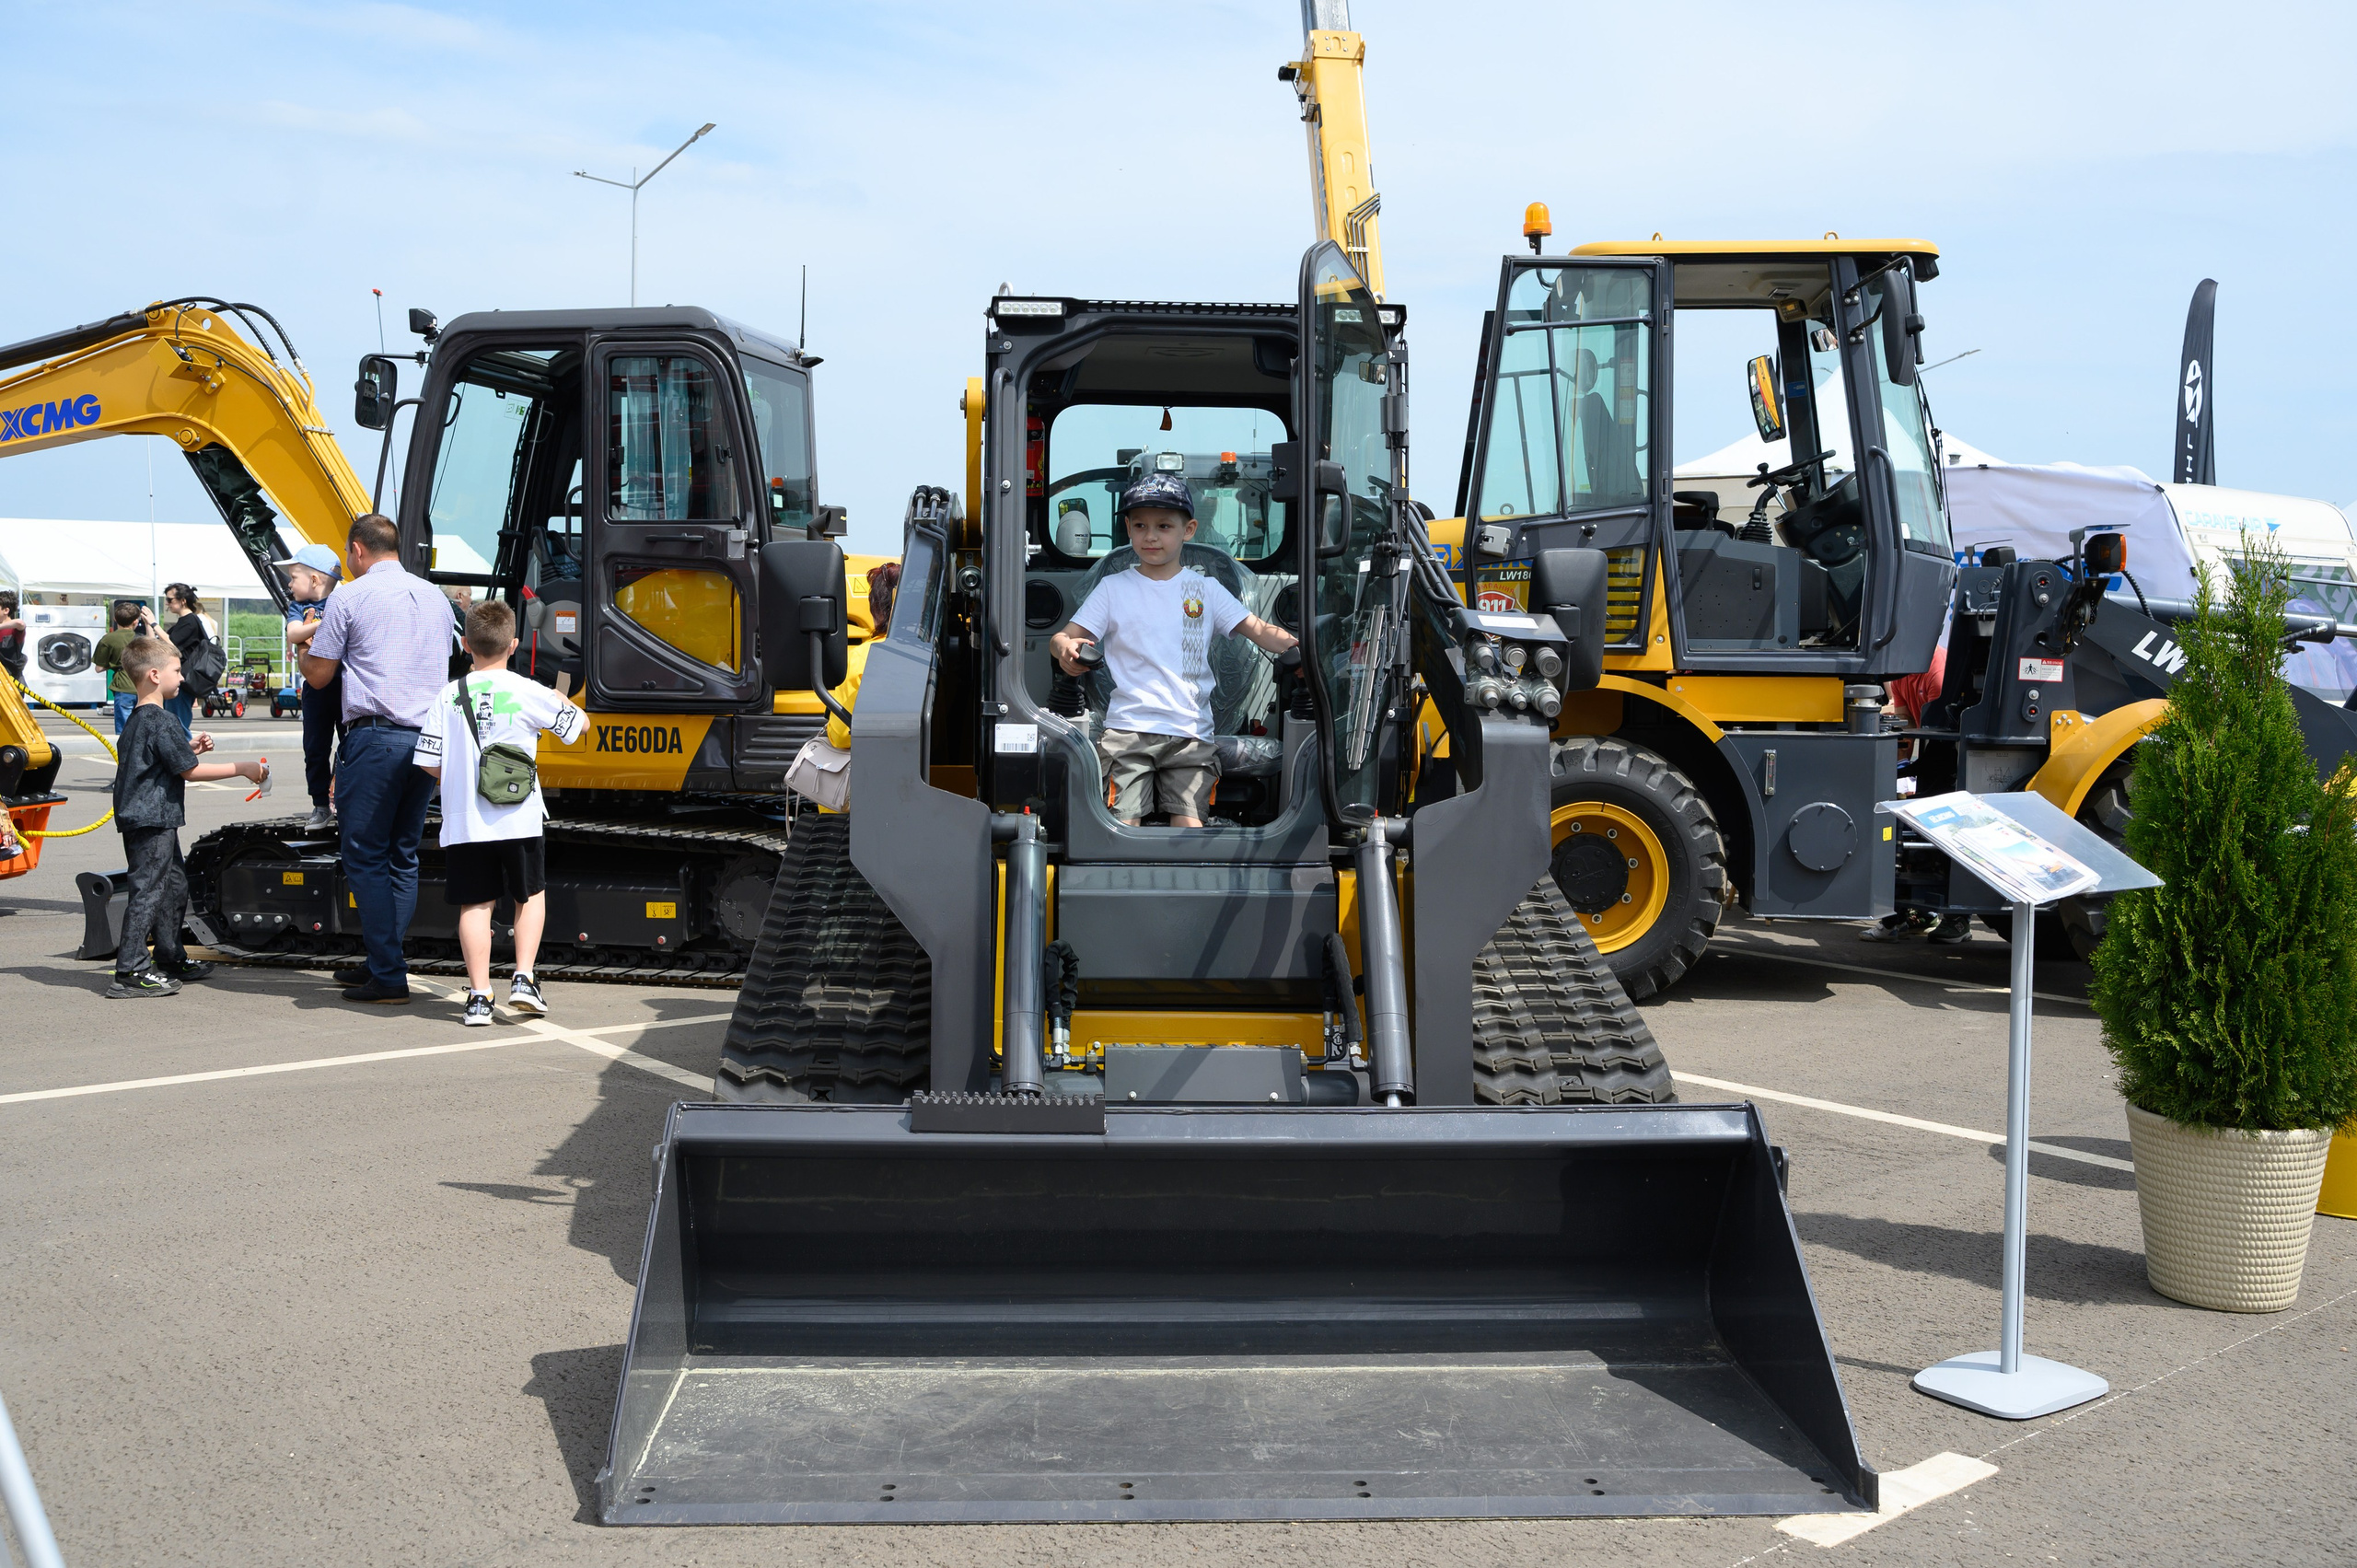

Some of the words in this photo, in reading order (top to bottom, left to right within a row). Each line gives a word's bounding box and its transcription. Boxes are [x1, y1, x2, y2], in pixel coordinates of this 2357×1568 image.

[0, 394, 101, 441] XCMG
[1477, 582, 1515, 595] ОМПАНИЯ
[1479, 599, 1506, 612] 911
[596, 725, 683, 754] XE60DA
